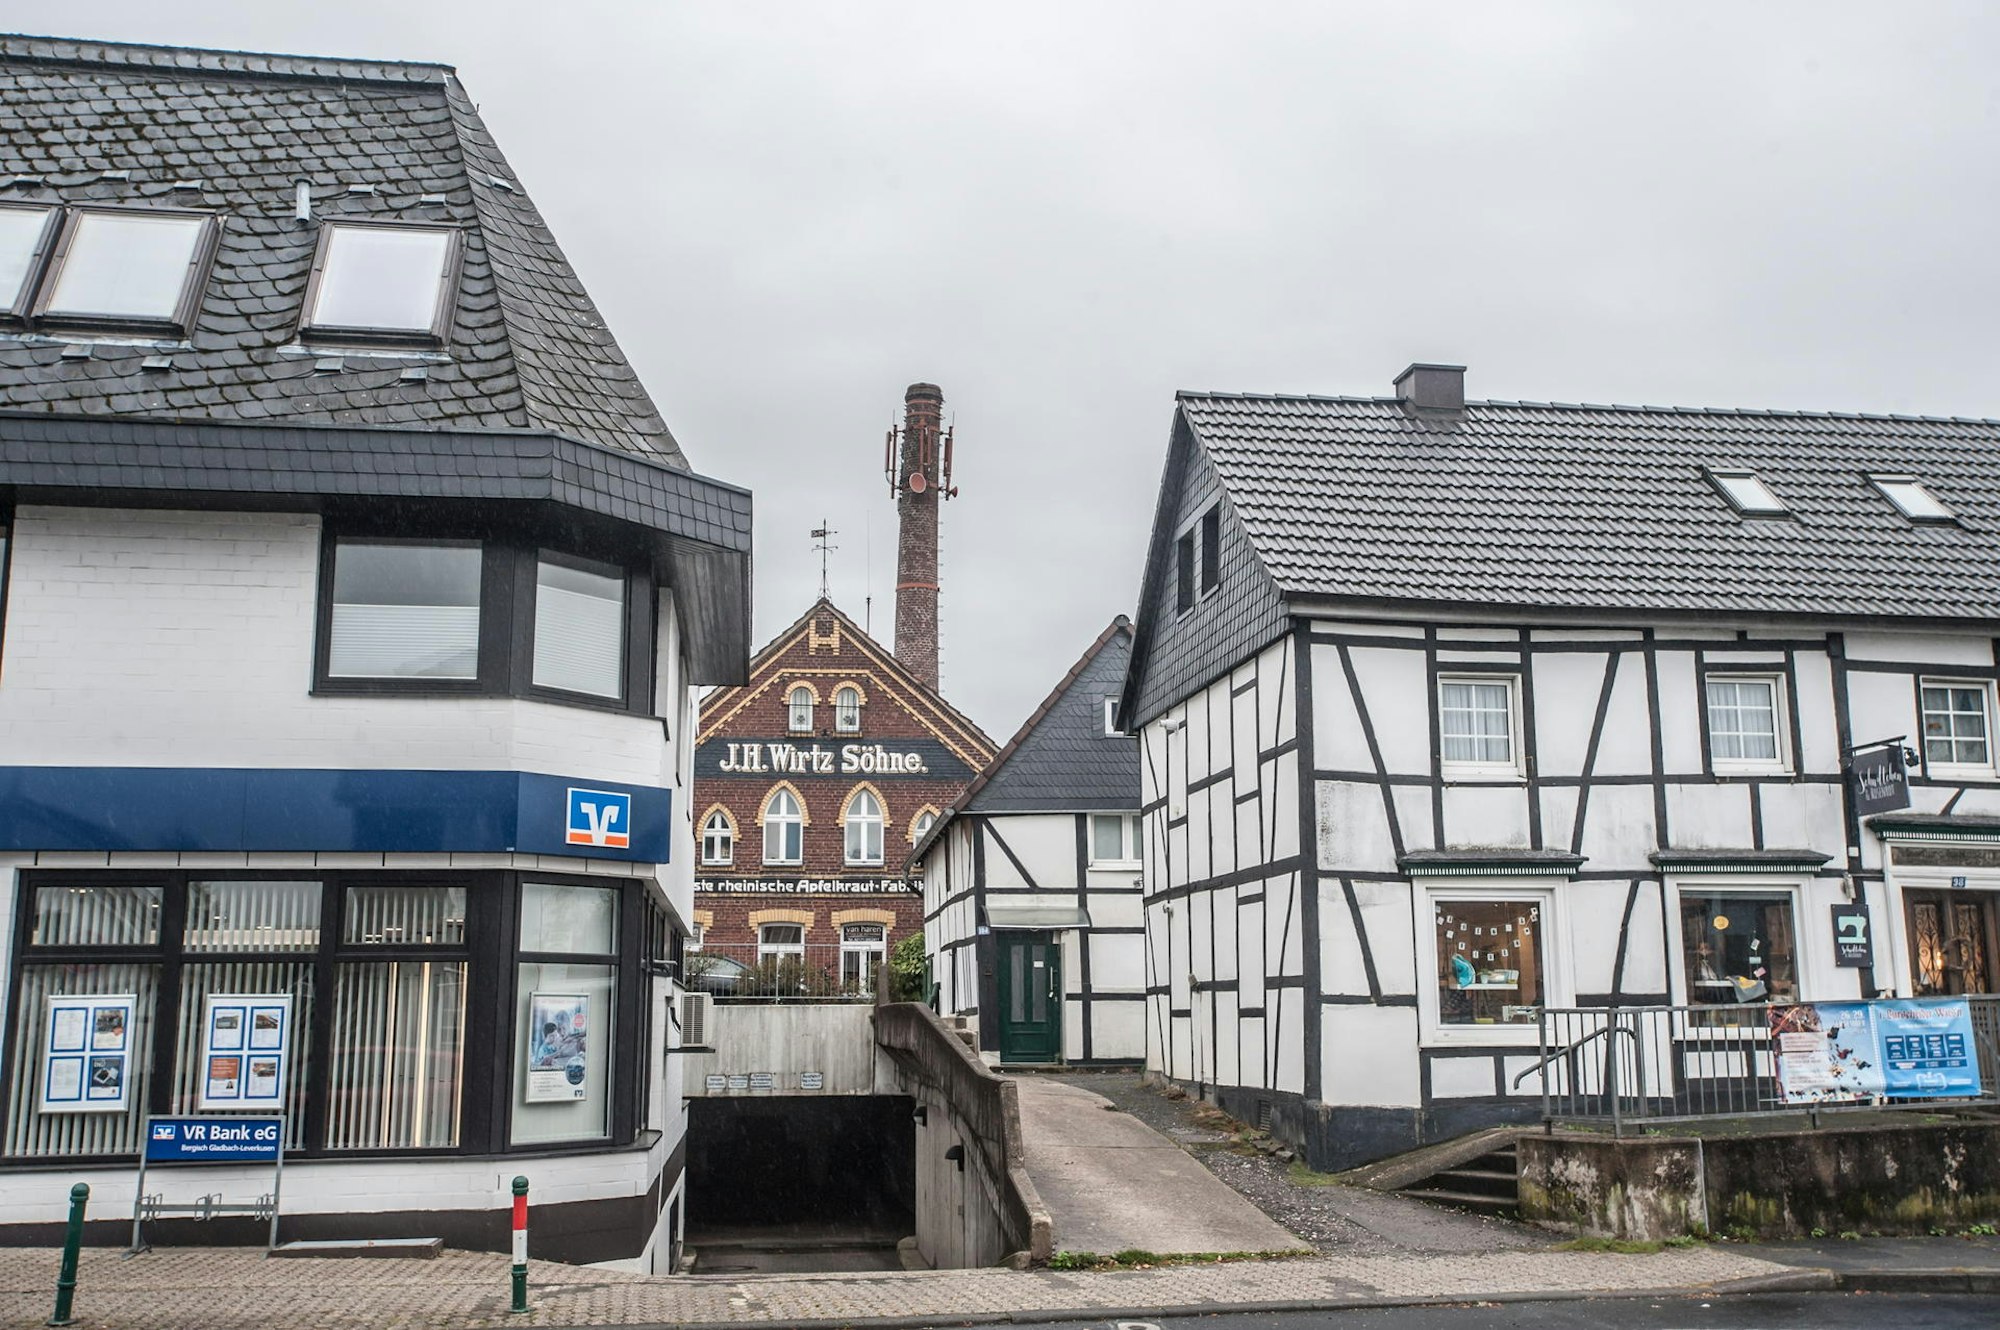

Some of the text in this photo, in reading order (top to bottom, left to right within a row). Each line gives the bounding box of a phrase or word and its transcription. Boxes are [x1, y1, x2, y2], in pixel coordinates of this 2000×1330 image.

[767, 743, 835, 773] Wirtz
[841, 744, 929, 774] Söhne.
[694, 879, 714, 892] ste
[718, 879, 794, 892] rheinische
[183, 1124, 277, 1140] VR Bank eG
[181, 1144, 208, 1153] Bergisch
